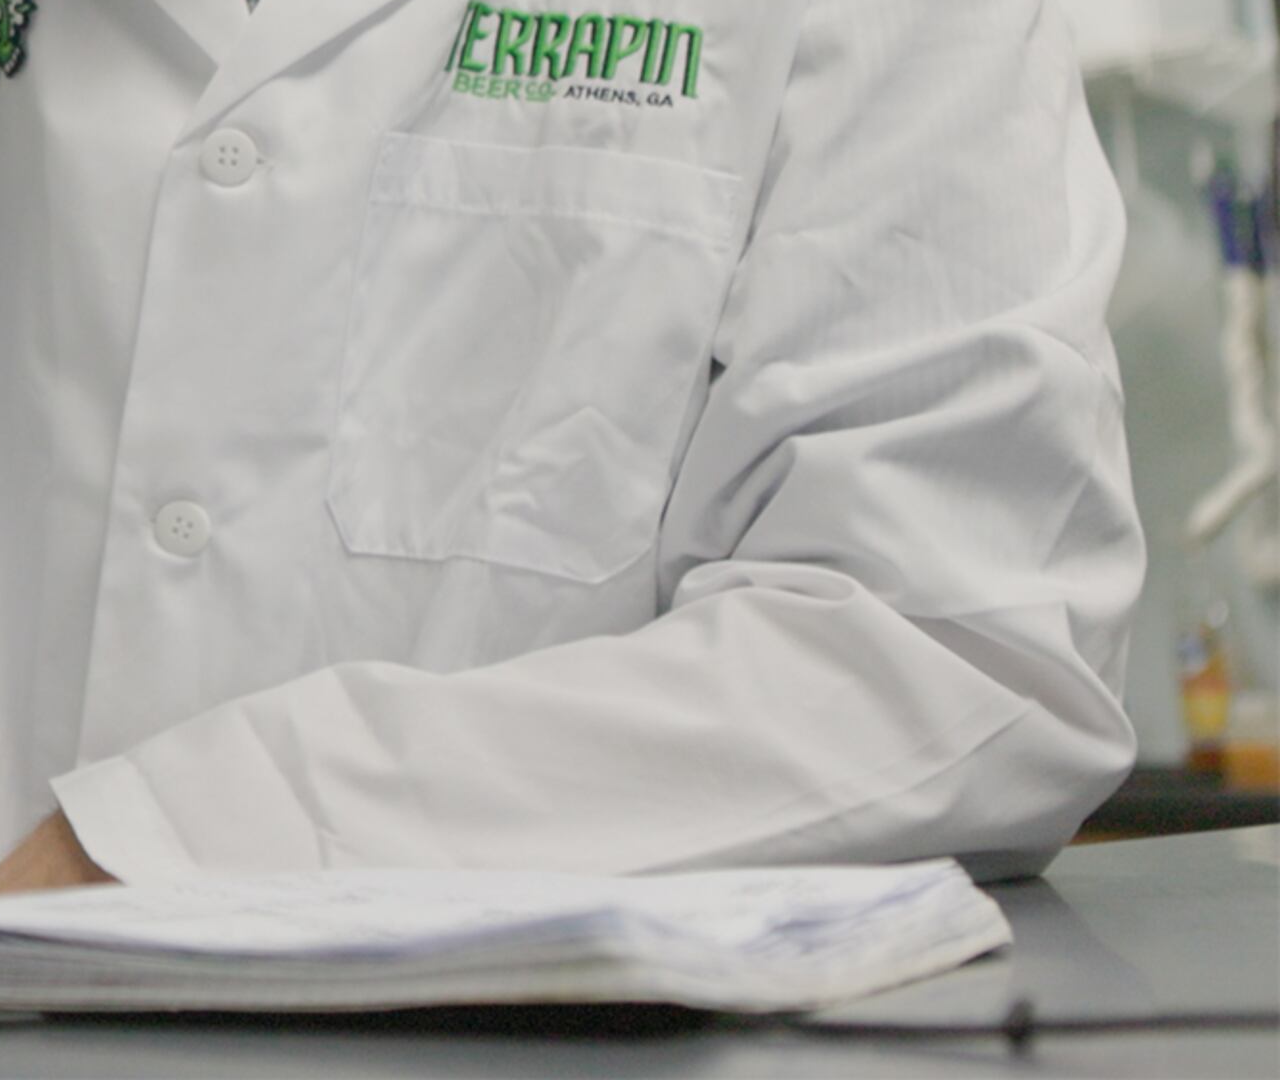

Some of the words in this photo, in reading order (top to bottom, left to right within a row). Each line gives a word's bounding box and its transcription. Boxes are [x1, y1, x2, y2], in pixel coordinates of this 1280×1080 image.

[453, 74, 520, 99] BEER
[563, 85, 642, 107] ATHENS,
[646, 92, 674, 108] GA
